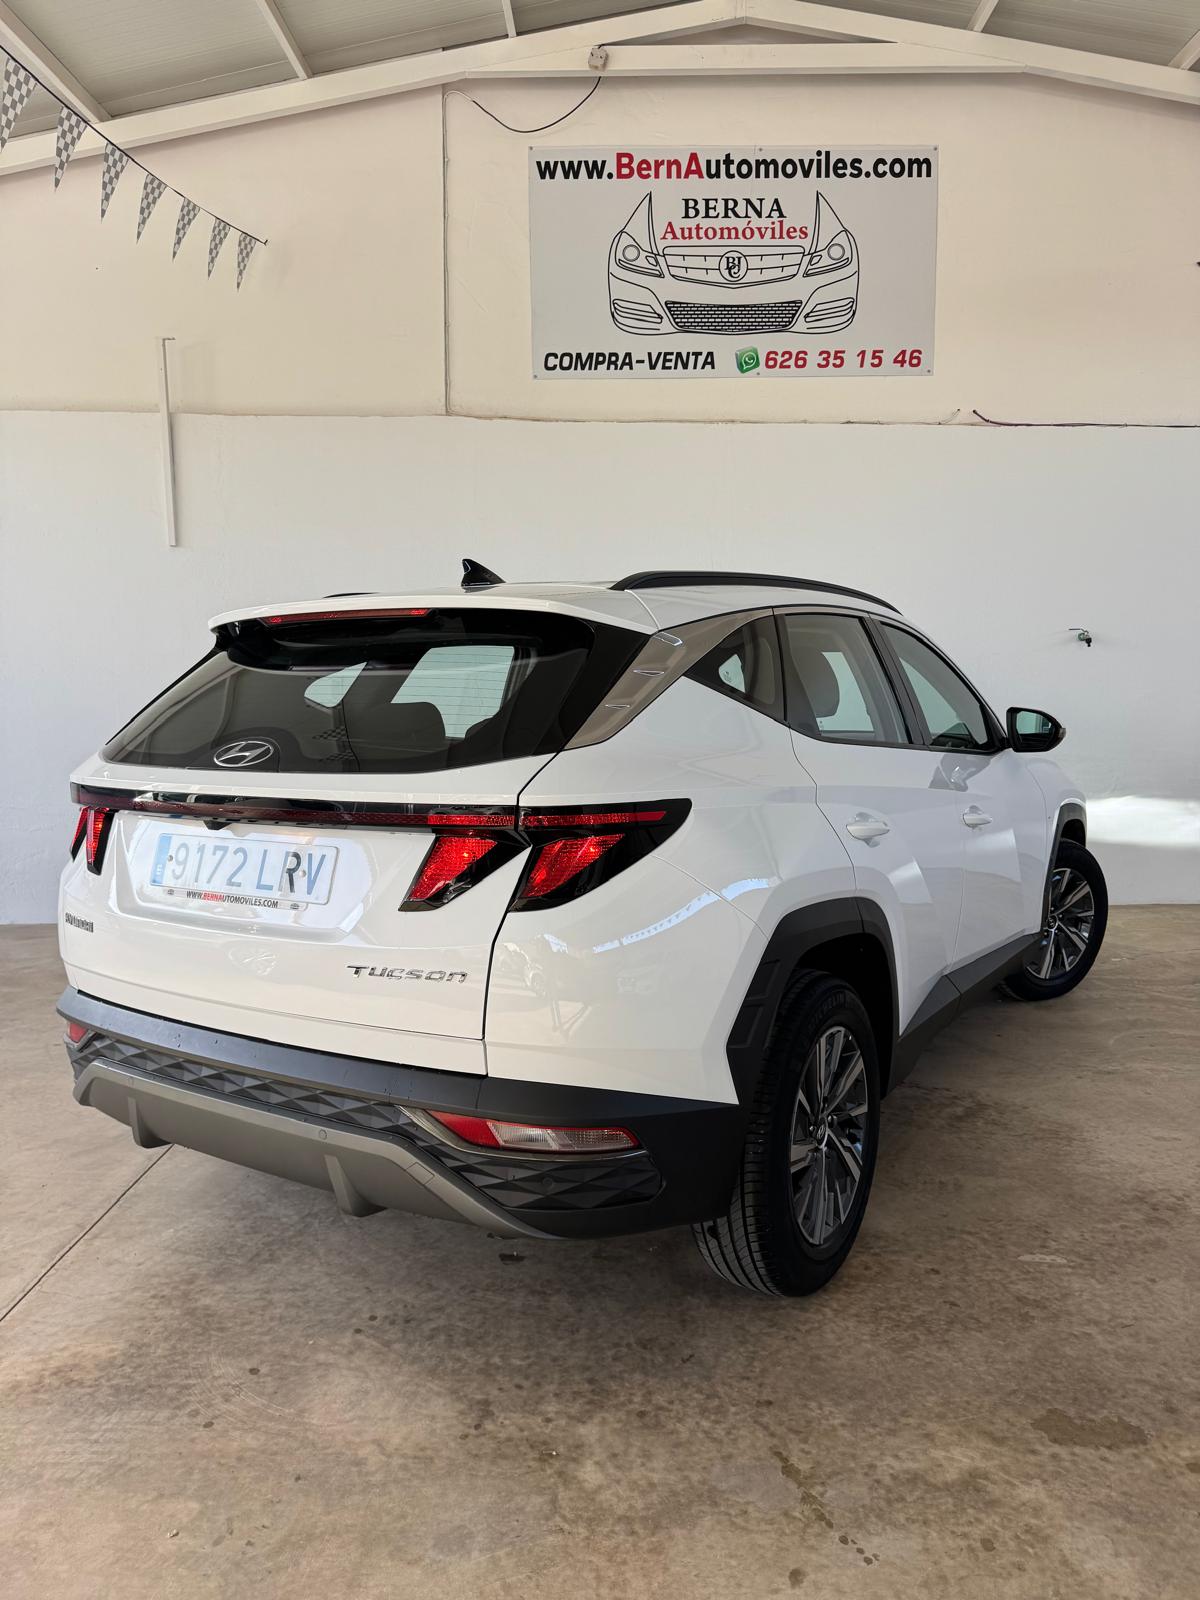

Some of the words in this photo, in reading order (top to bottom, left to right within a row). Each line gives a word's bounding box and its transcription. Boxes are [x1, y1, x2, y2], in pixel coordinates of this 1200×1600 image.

[535, 150, 932, 180] www.BernAutomoviles.com
[681, 197, 787, 219] BERNA
[660, 219, 809, 240] Automóviles
[543, 351, 716, 371] COMPRA-VENTA
[764, 350, 808, 369] 626
[816, 350, 846, 369] 35
[856, 349, 884, 368] 15
[892, 349, 923, 368] 46
[171, 842, 248, 888] 9172
[255, 849, 327, 896] LRV
[186, 890, 279, 909] WWW.BERNAUTOMOVILES.COM
